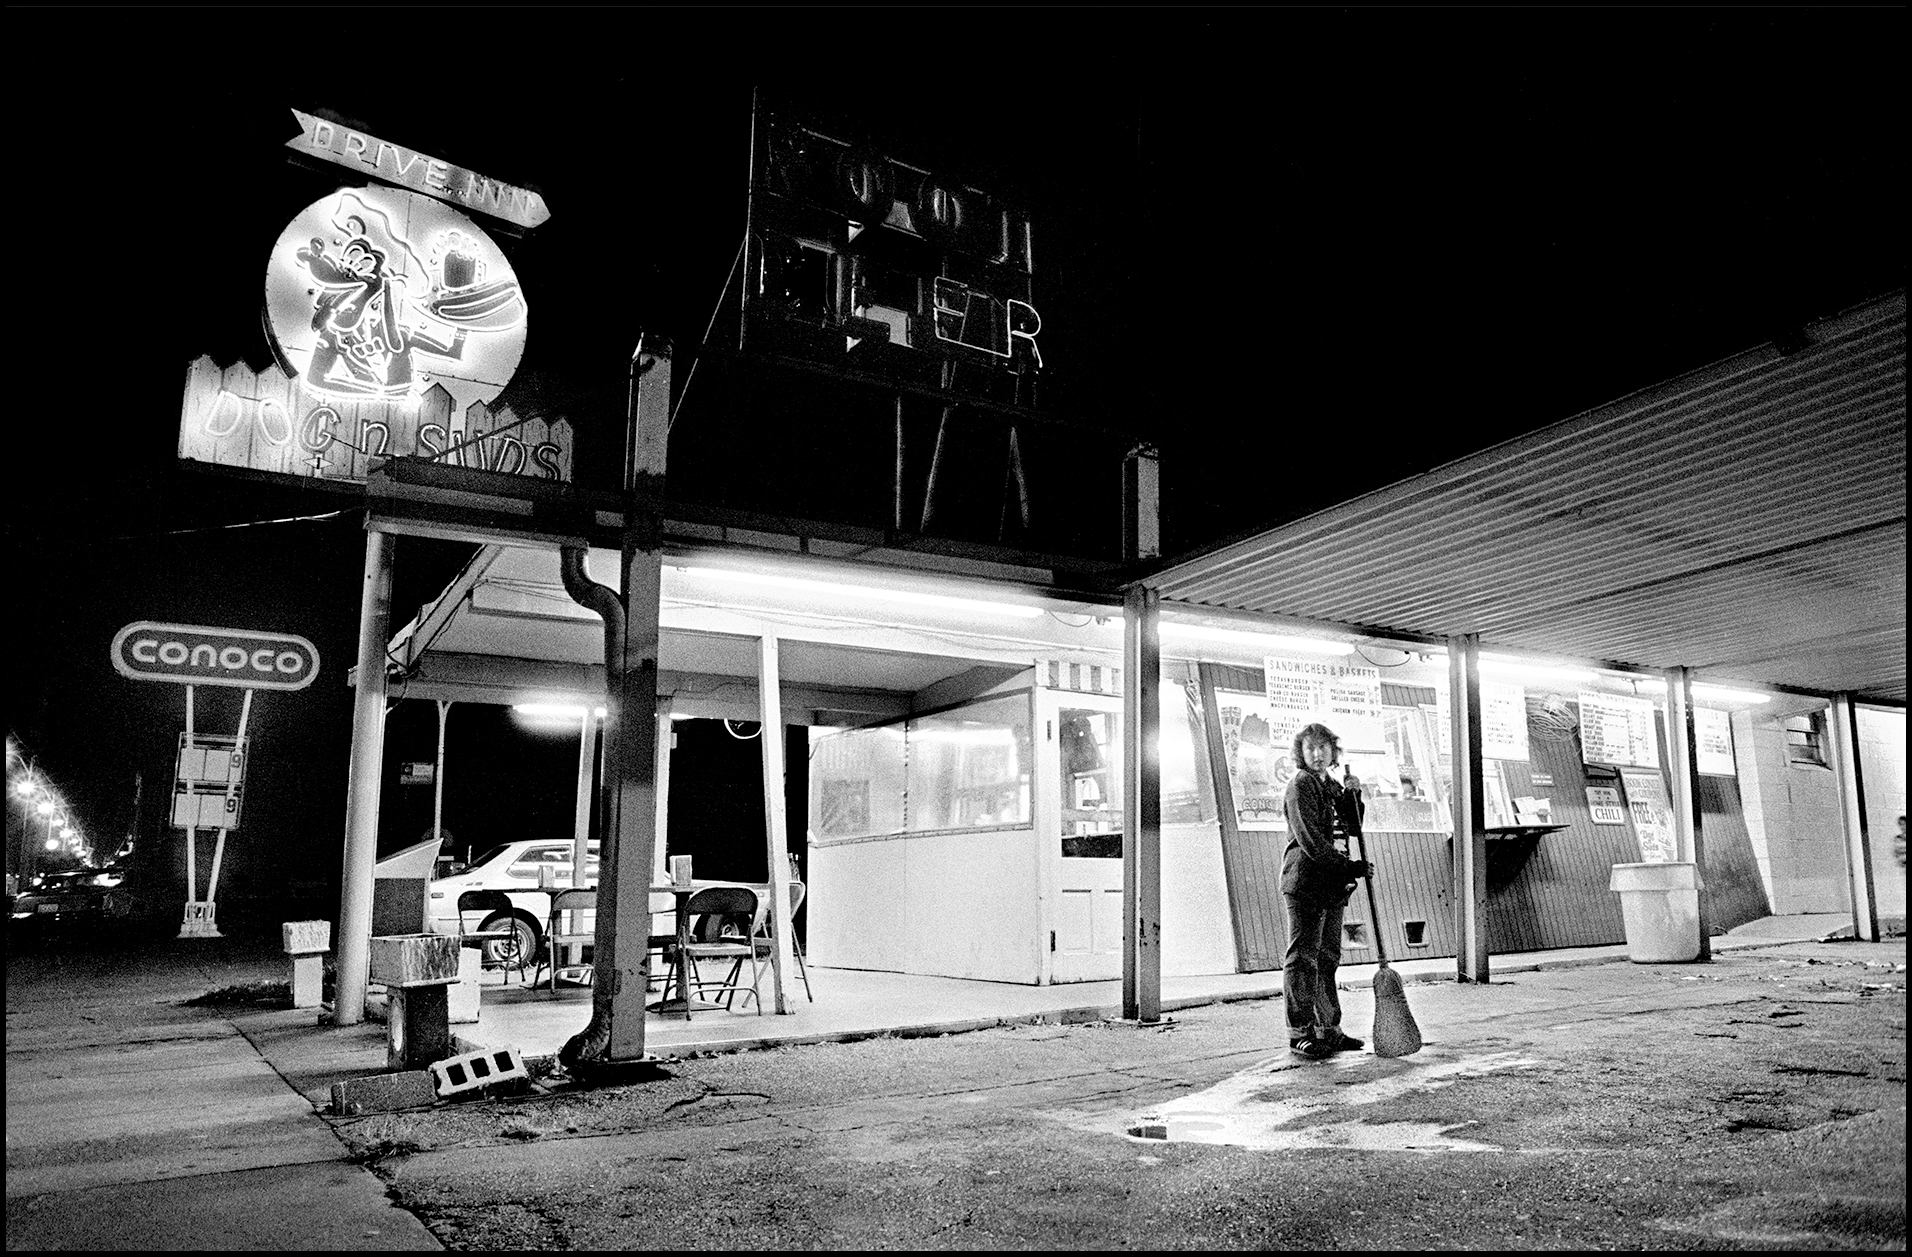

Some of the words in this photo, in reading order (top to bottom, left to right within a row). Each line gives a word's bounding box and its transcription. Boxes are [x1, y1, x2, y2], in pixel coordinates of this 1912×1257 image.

[311, 120, 447, 189] DRIVE
[204, 390, 341, 452] DOG
[418, 422, 563, 481] SUDS
[1270, 659, 1327, 675] SANDWICHES
[1339, 667, 1376, 679] BASKETS
[1595, 808, 1621, 820] CHILI
[1631, 801, 1652, 825] FREE
